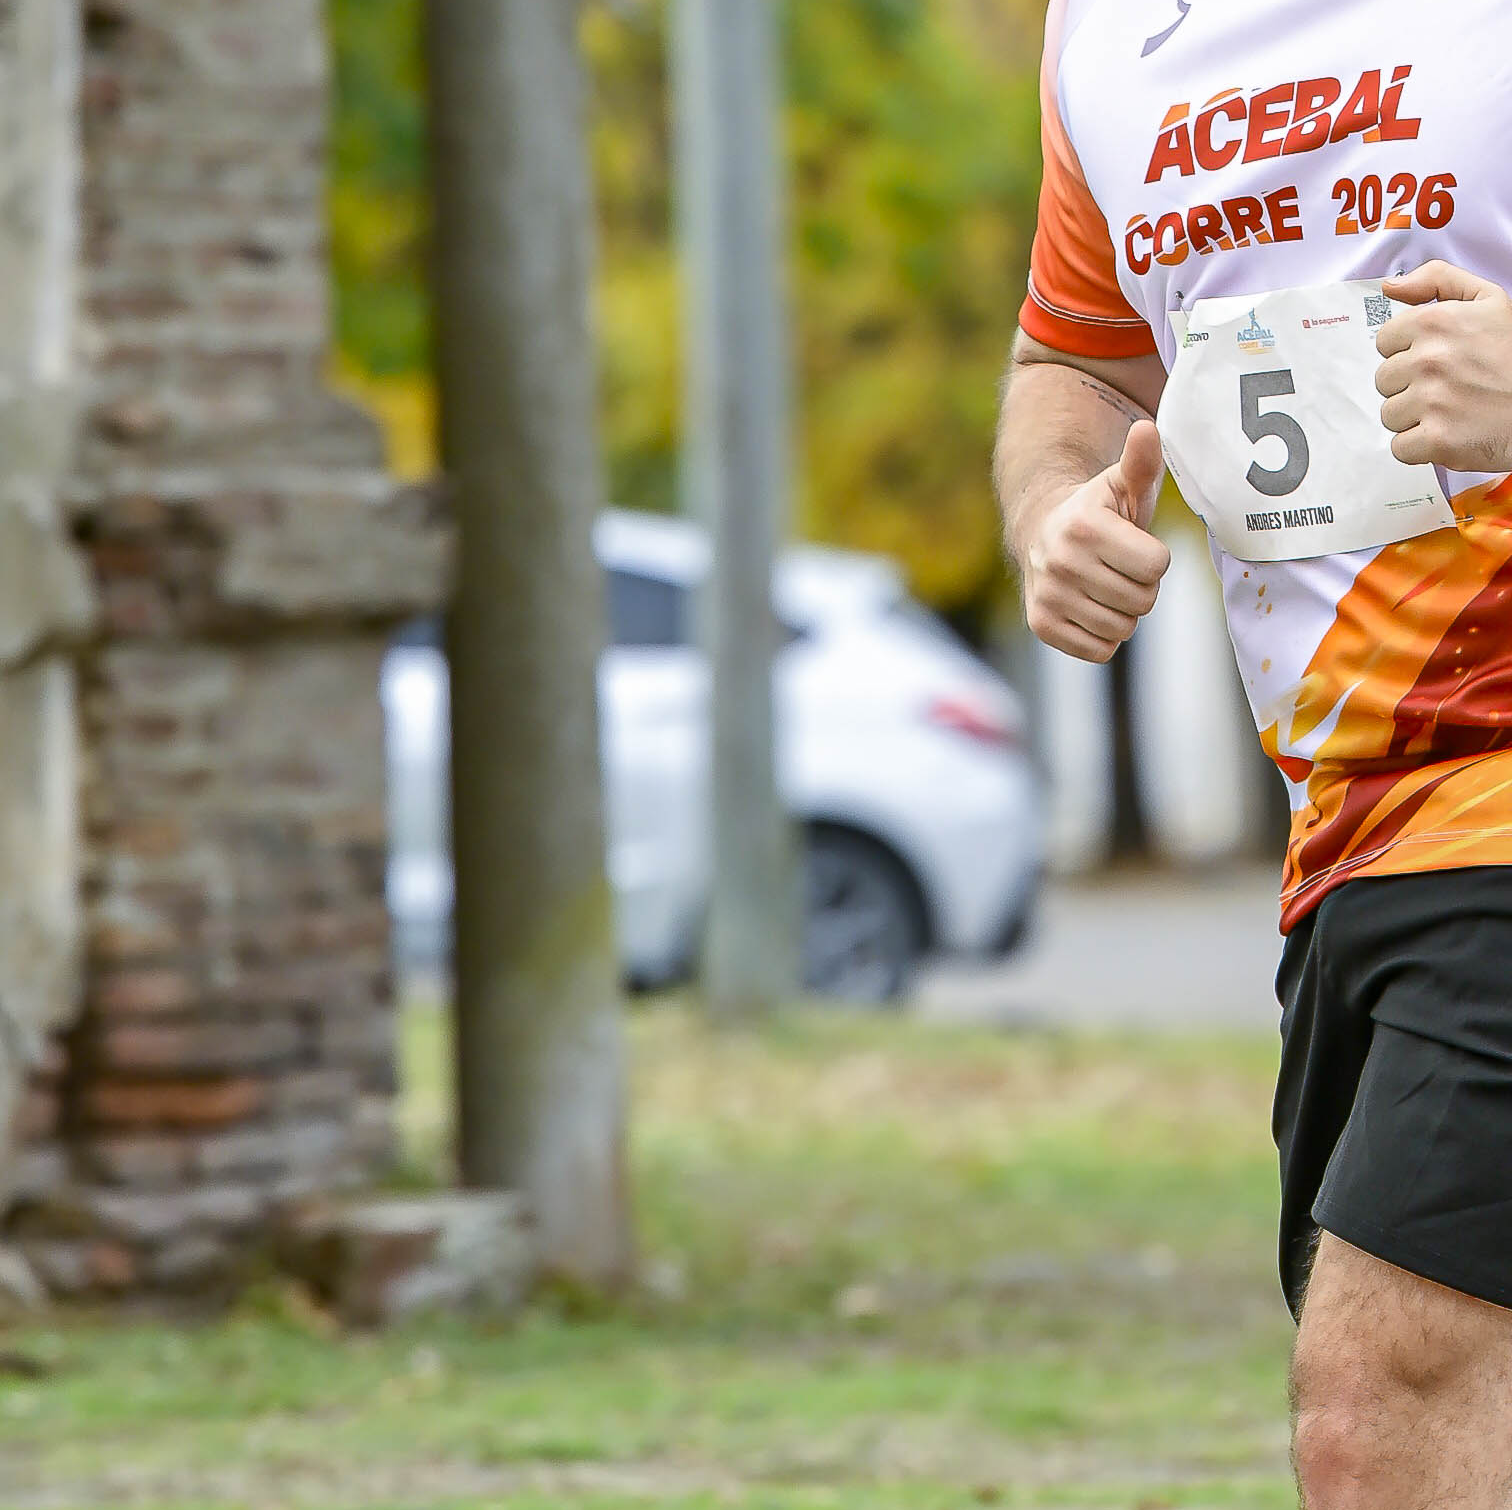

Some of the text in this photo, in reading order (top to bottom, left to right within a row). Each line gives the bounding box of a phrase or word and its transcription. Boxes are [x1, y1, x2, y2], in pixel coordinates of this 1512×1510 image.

[1144, 65, 1422, 183] ACEBAL
[1125, 172, 1457, 275] CORRE 2026
[1240, 369, 1310, 496] 5
[1245, 505, 1334, 532] ANDRES MARTINO
